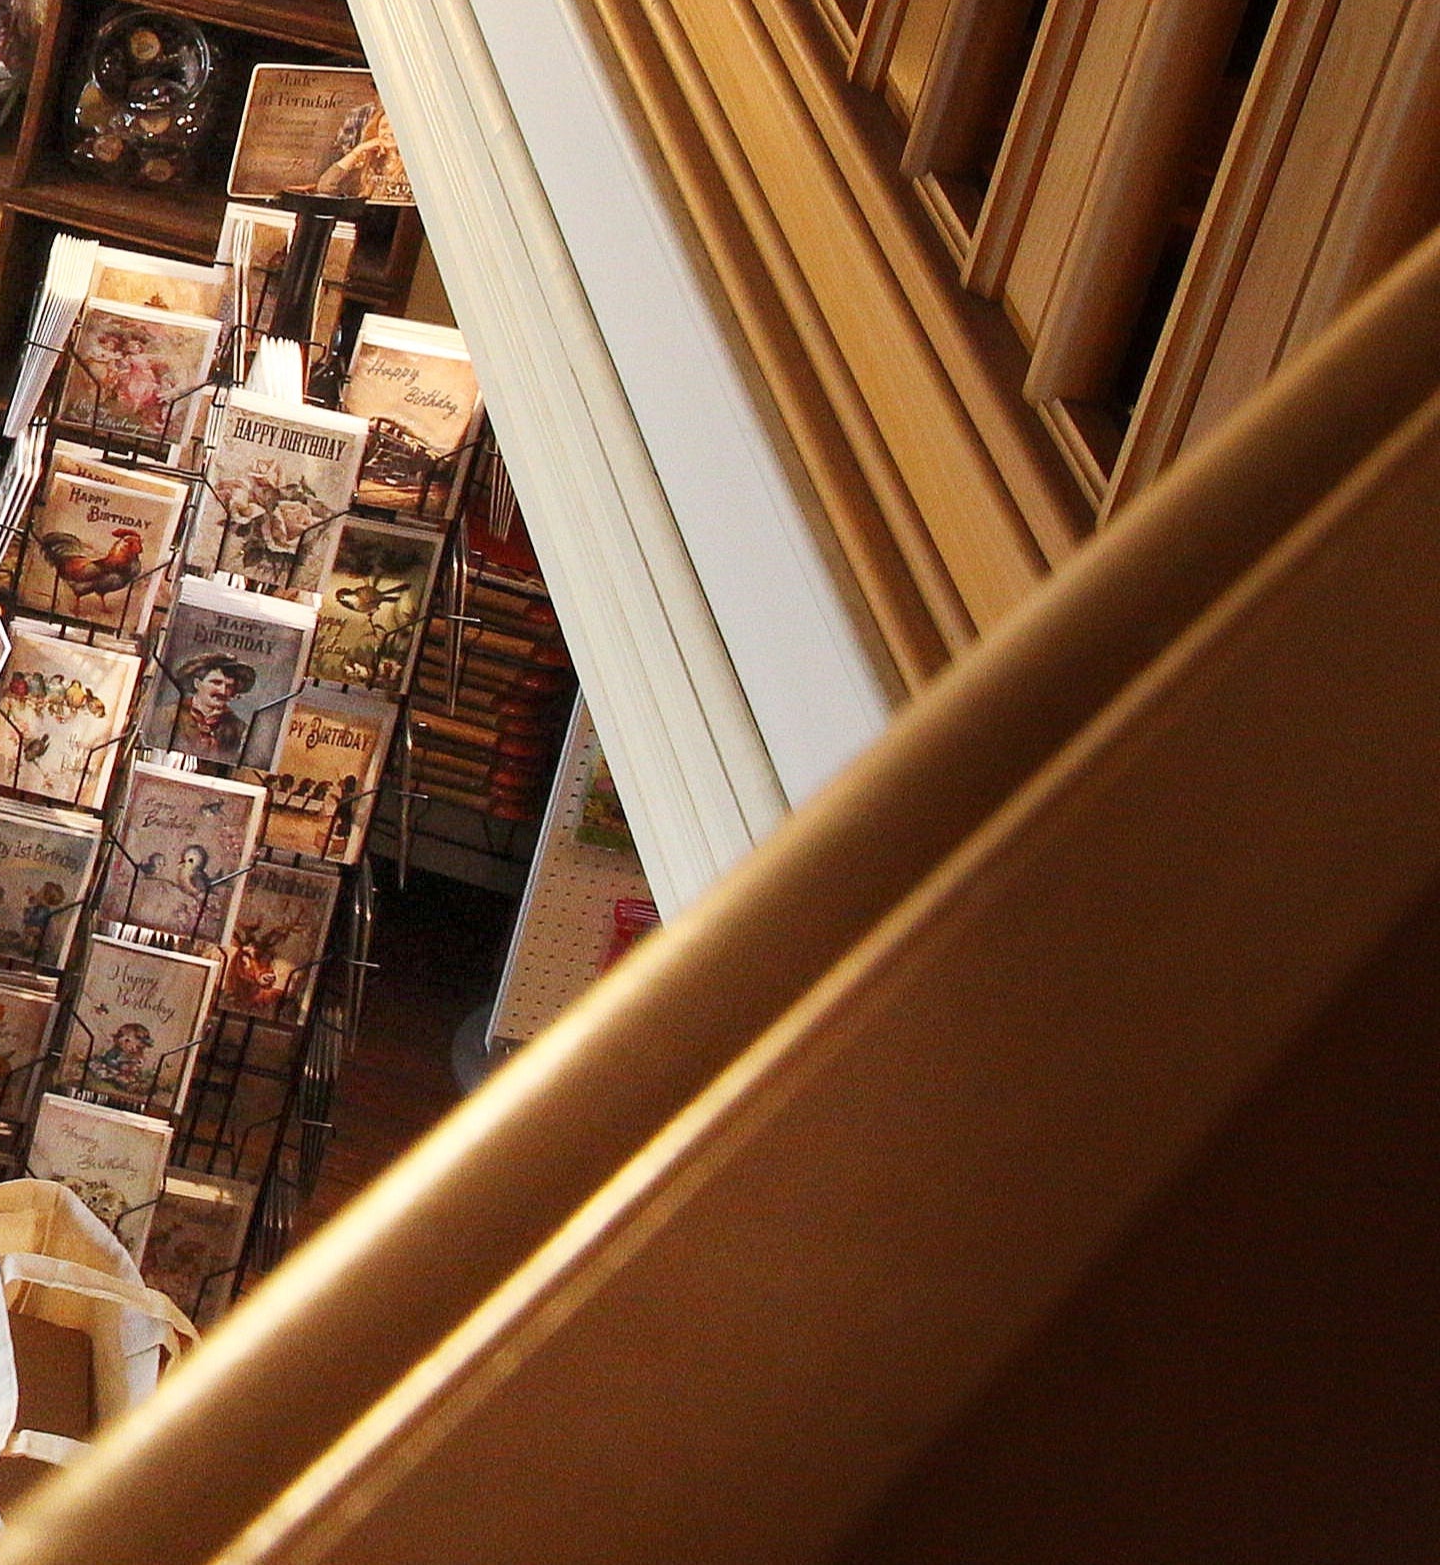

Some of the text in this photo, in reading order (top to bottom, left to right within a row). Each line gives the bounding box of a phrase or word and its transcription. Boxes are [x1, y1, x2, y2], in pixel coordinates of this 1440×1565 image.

[366, 358, 421, 385] Happy
[404, 386, 461, 418] Birthday
[235, 417, 347, 464] HAPPY BIRTHDAY
[69, 486, 111, 507] HAPPY
[85, 505, 153, 530] BIRTHDAY
[214, 615, 268, 634] HAPPY
[193, 624, 276, 656] BIRTHDAY
[307, 717, 375, 752] BIRTHDAY
[108, 964, 160, 990] Happy
[116, 986, 176, 1021] Birthday
